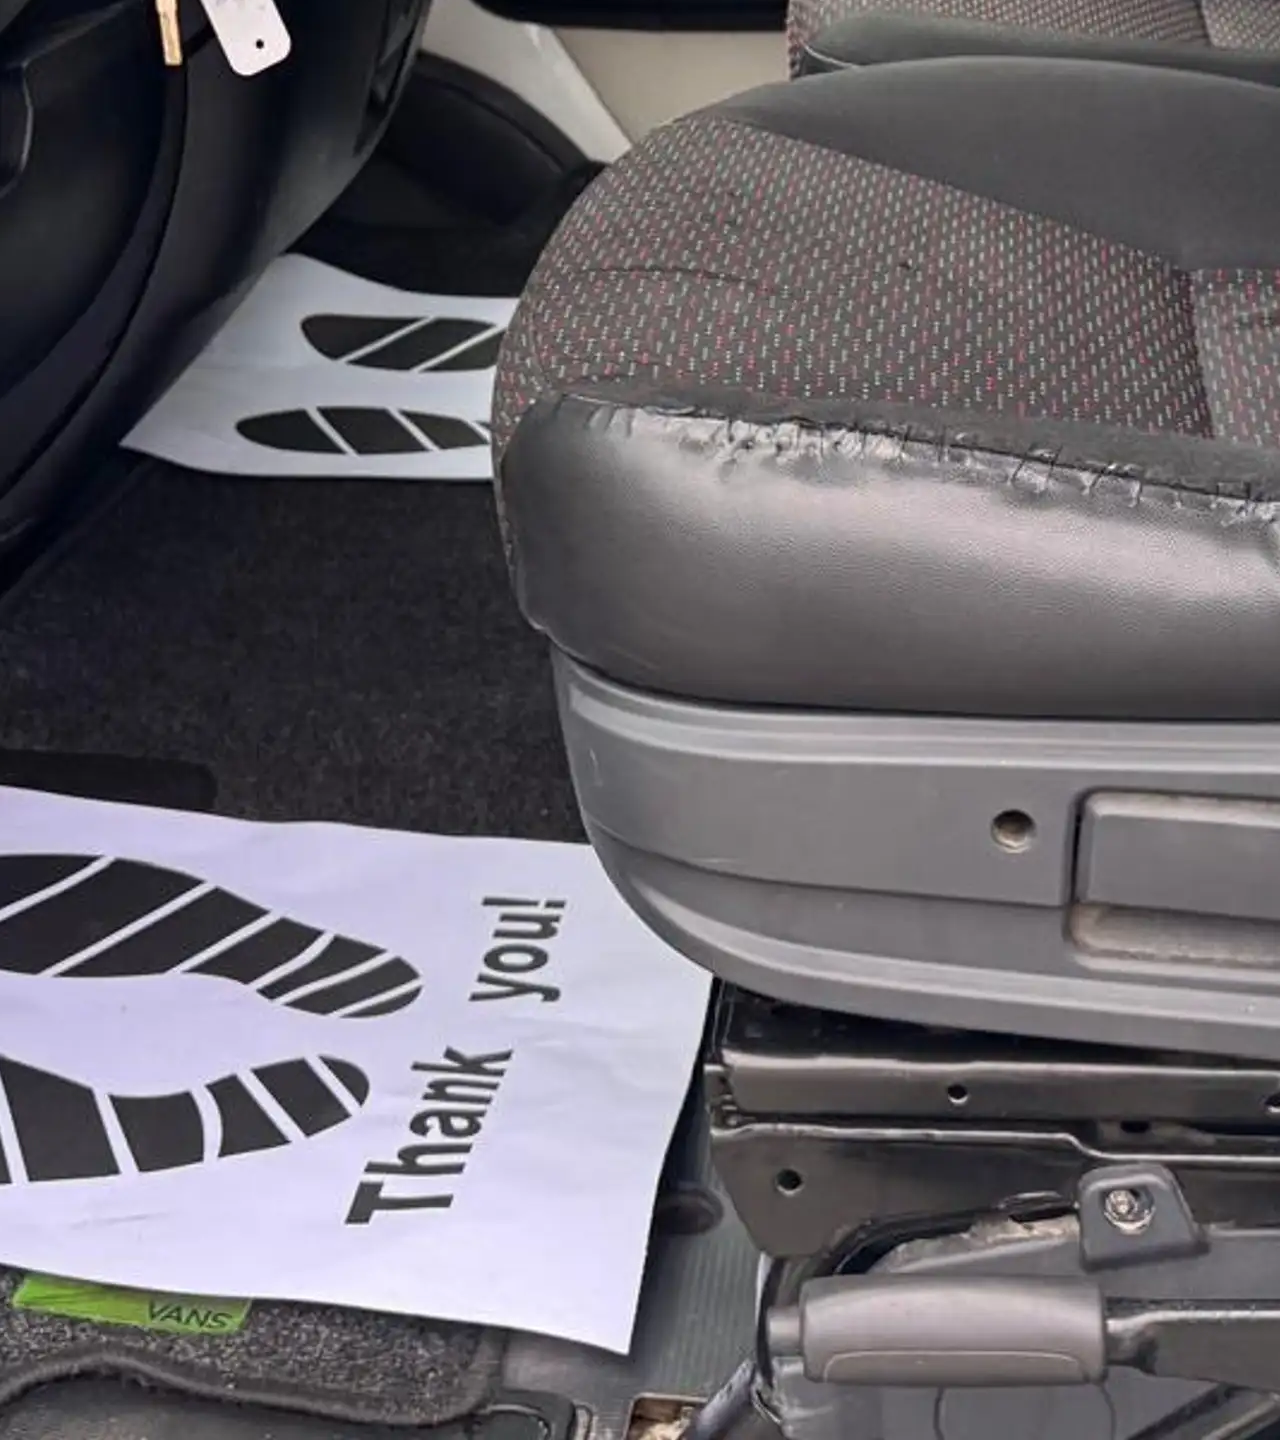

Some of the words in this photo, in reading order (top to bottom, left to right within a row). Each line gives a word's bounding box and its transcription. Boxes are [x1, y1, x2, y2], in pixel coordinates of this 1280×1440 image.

[345, 1046, 514, 1225] Thank
[469, 896, 567, 1002] you!
[147, 1299, 236, 1329] VANS
